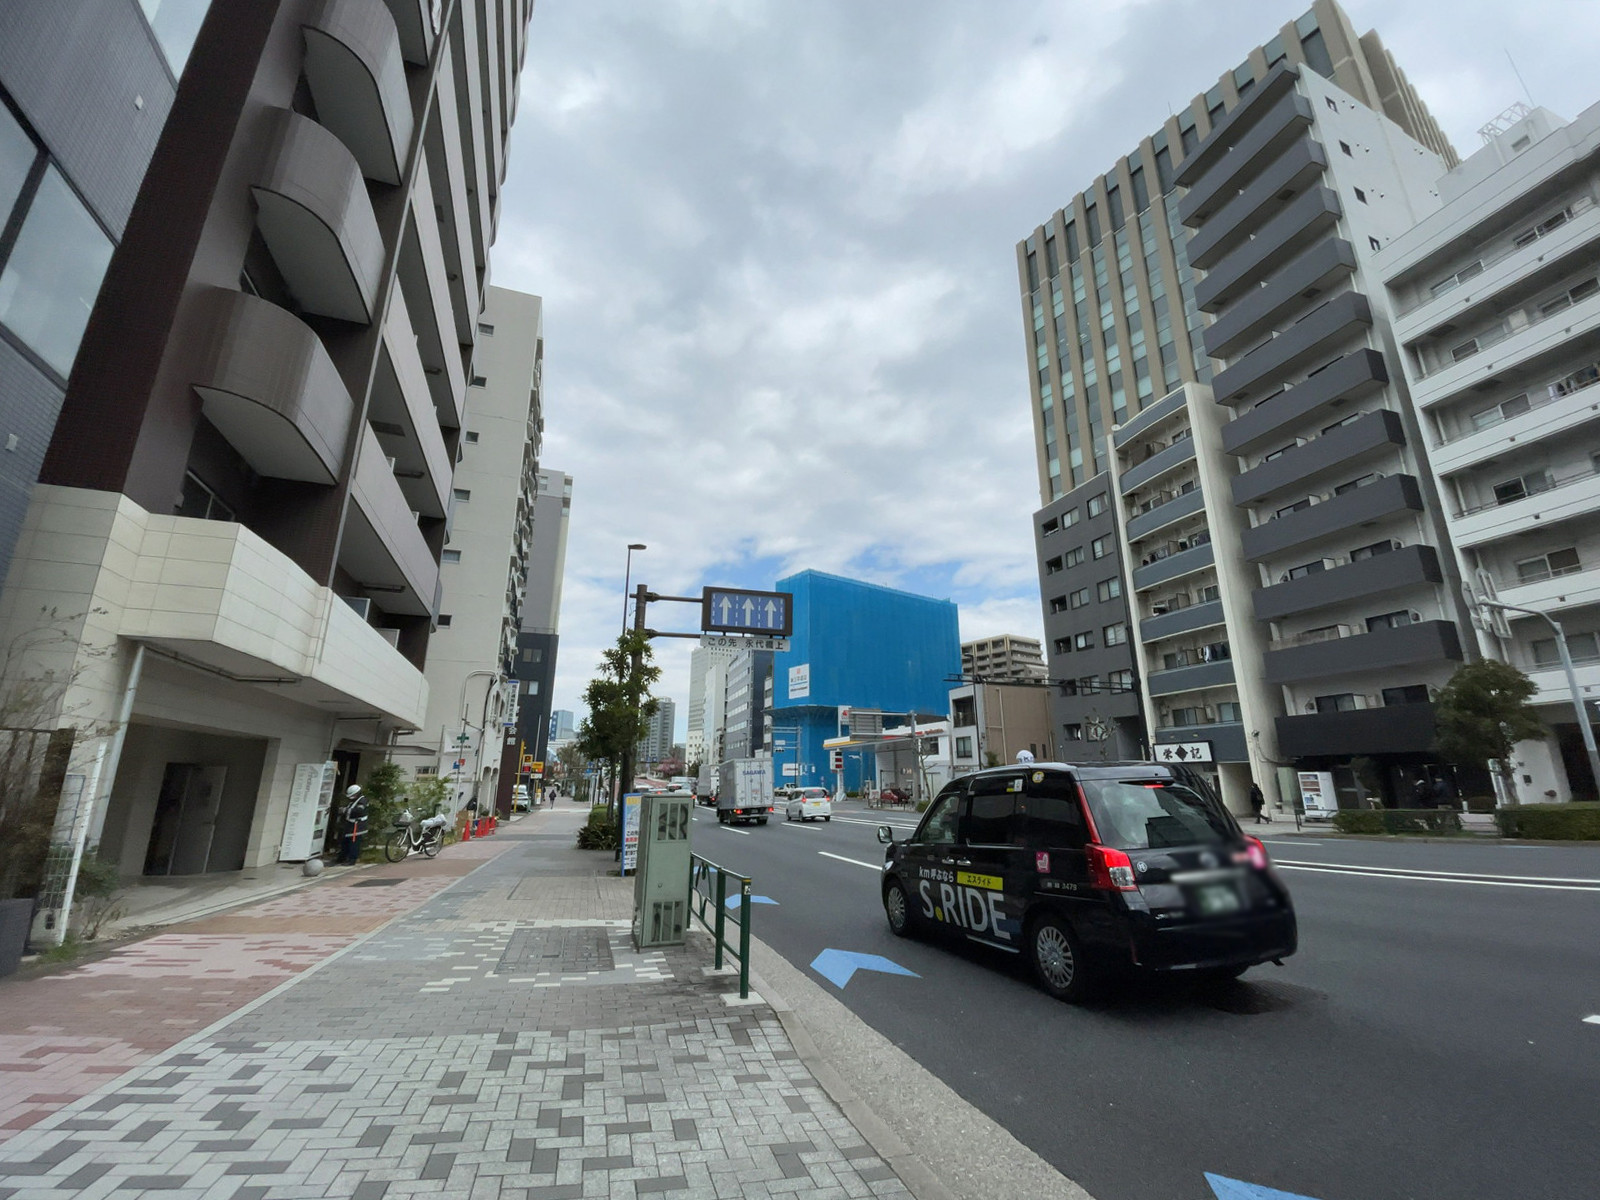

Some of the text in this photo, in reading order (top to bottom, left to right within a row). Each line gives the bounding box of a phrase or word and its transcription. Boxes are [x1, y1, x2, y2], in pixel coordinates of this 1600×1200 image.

[707, 637, 784, 650] この先 永代橋上
[966, 874, 992, 887] エスライド
[919, 879, 1012, 940] S.RIDE
